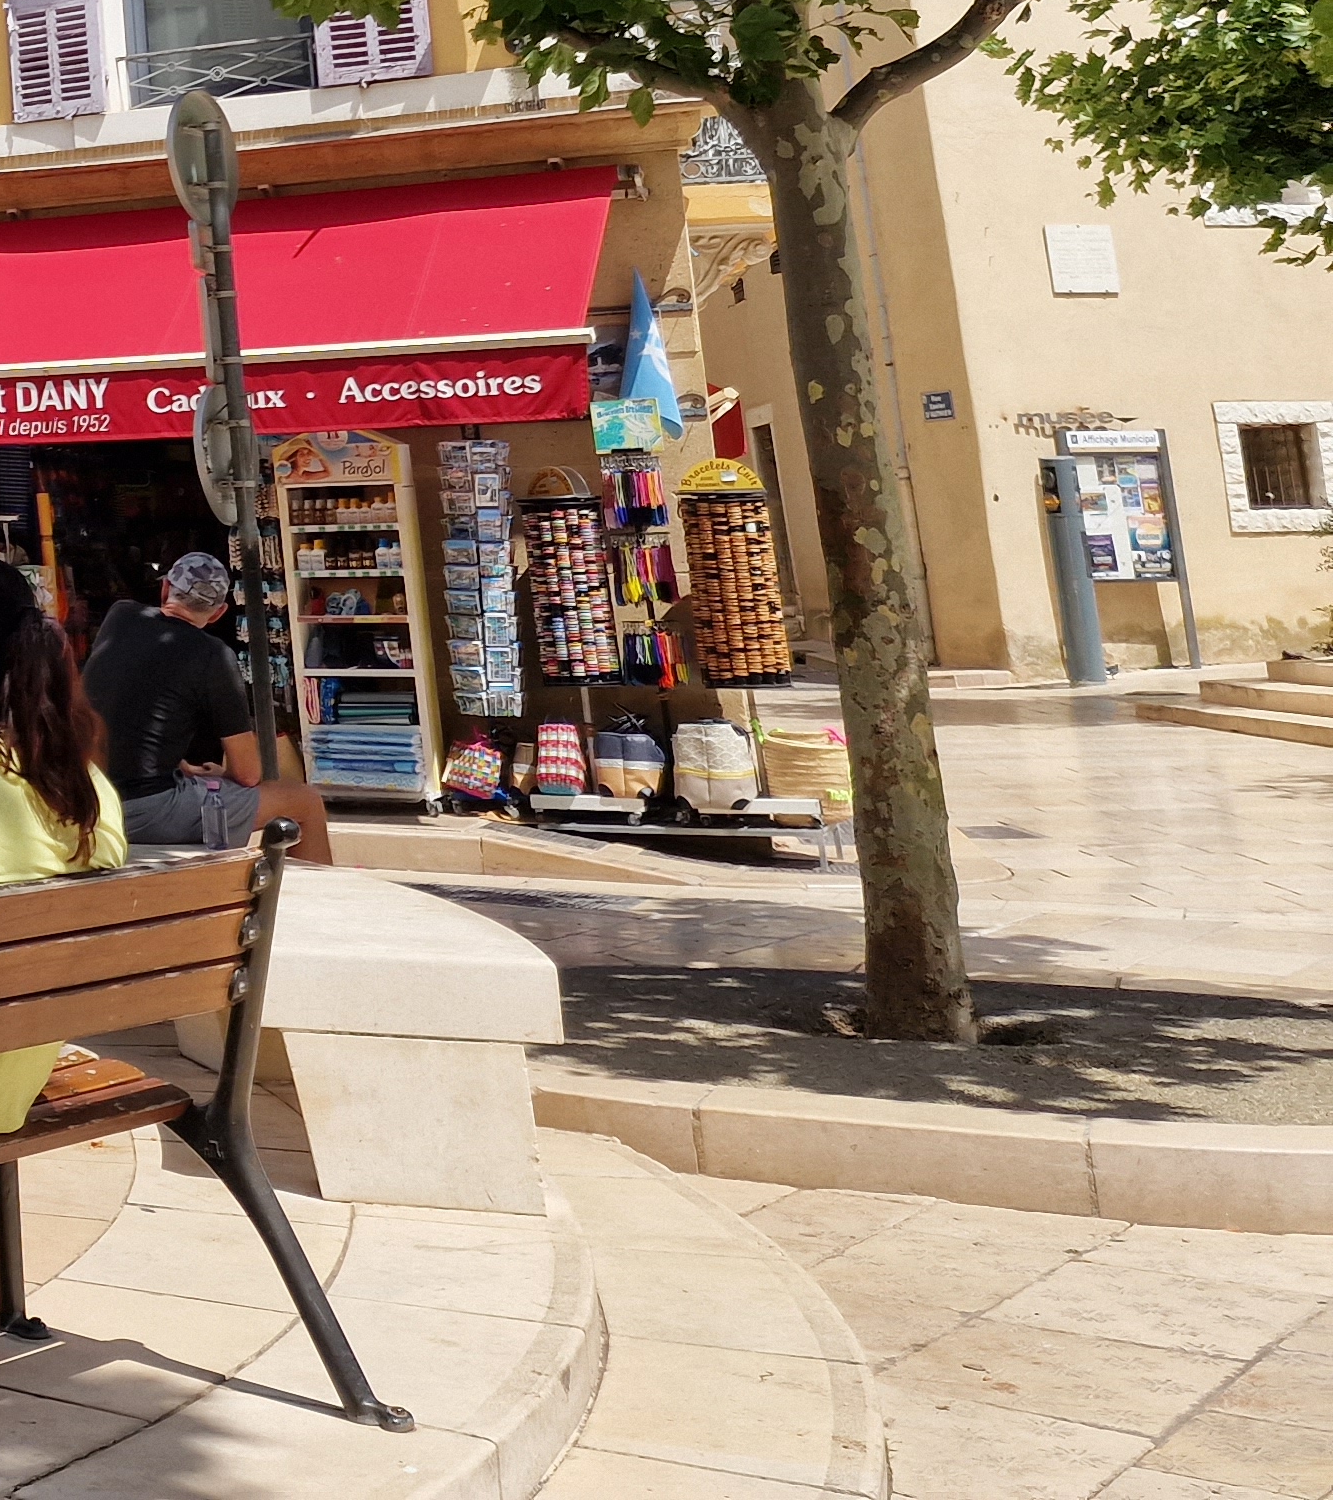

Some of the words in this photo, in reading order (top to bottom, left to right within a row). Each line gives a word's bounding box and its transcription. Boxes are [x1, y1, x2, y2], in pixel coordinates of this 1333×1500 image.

[15, 378, 110, 413] DANY
[146, 384, 286, 414] Cadux
[339, 370, 542, 404] Accessoires
[8, 415, 68, 438] depuis
[71, 414, 112, 434] 1952
[1016, 406, 1115, 426] musée
[1082, 434, 1119, 446] Affichage
[1120, 433, 1157, 444] Municipal
[680, 460, 731, 486] Bracelets
[736, 464, 758, 486] Cuir
